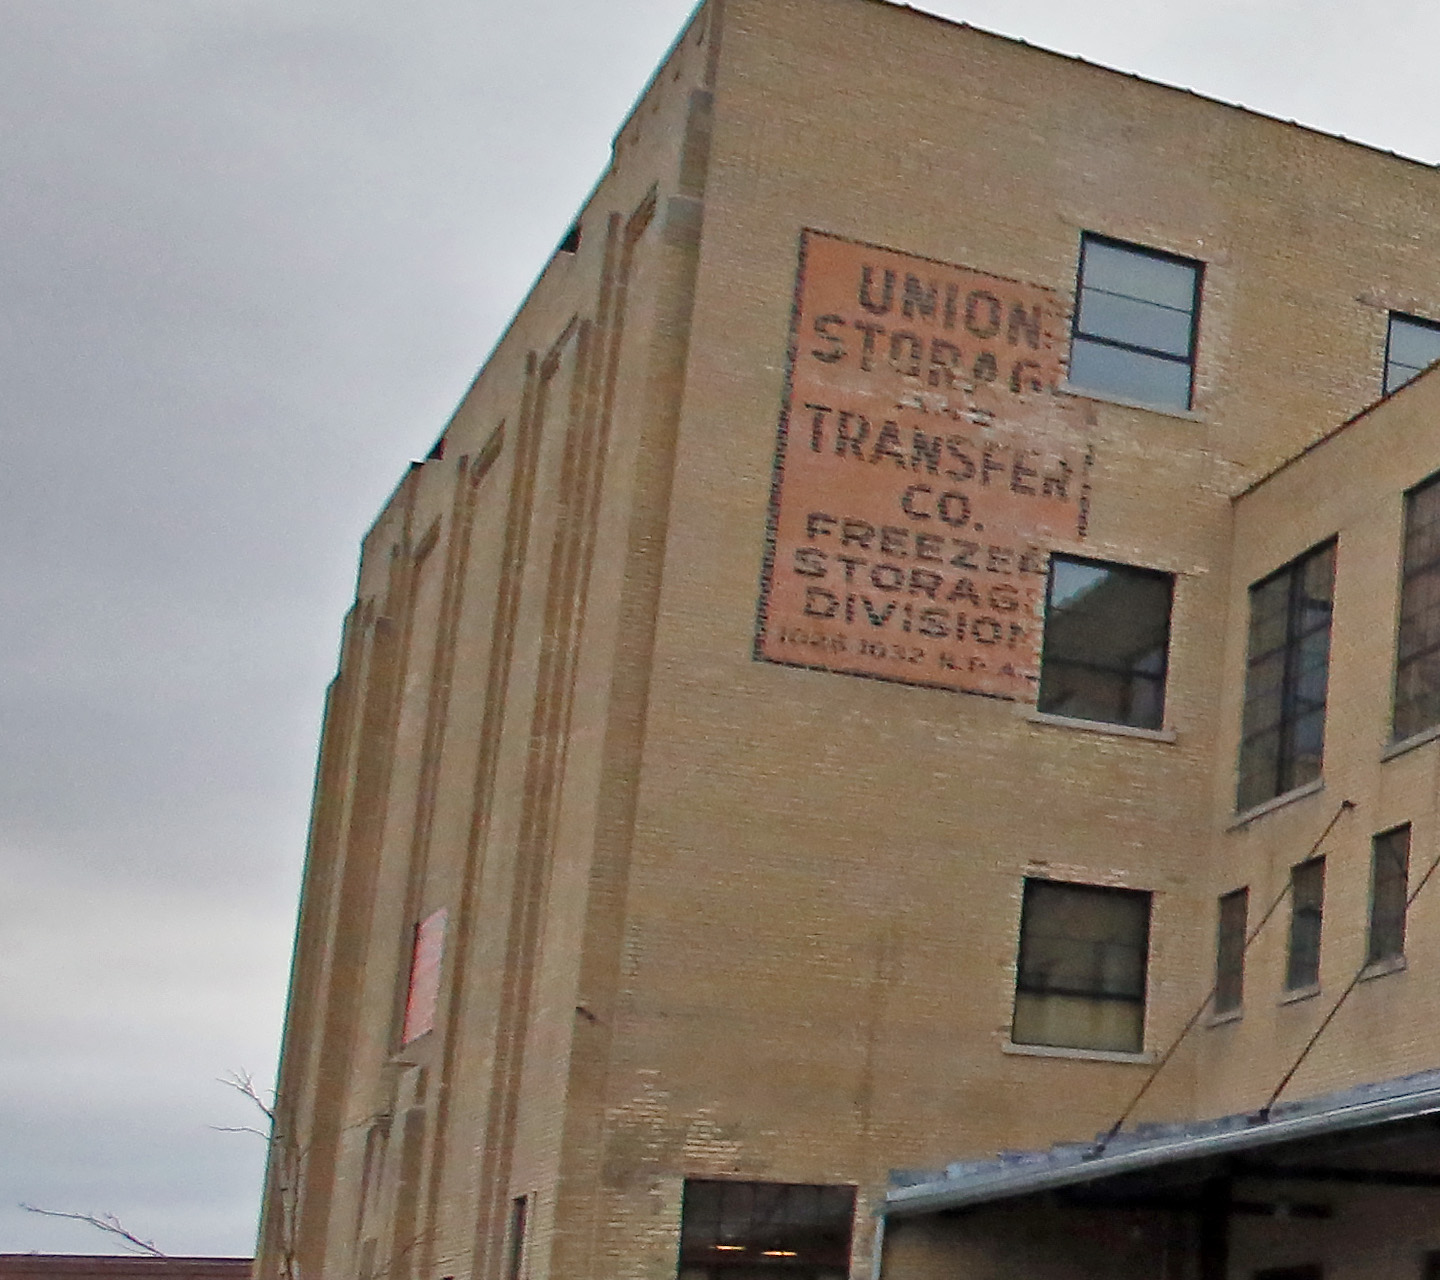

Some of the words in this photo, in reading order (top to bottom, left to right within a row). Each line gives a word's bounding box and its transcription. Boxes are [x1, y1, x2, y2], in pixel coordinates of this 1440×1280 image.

[858, 263, 1043, 350] UNION
[810, 312, 1045, 394] STORAG
[804, 402, 1073, 499] TRANSFER
[900, 483, 985, 532] CO.
[792, 546, 1038, 613] STORAG
